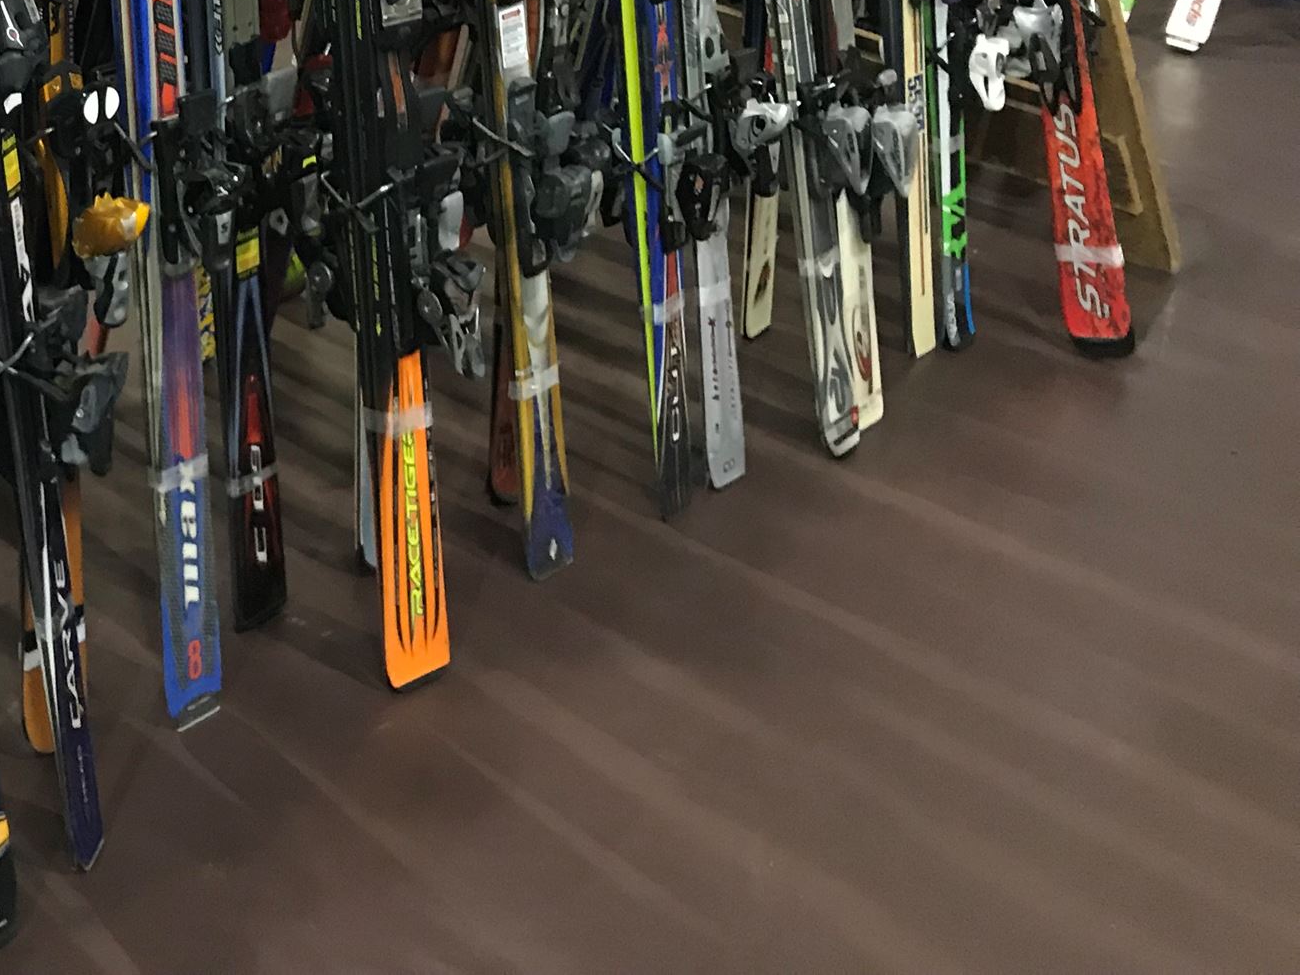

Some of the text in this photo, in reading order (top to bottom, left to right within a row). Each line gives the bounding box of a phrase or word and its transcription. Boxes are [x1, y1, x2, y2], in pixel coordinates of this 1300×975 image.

[1053, 103, 1102, 319] STRATUS
[53, 558, 84, 729] CARVE
[405, 519, 425, 616] RACE
